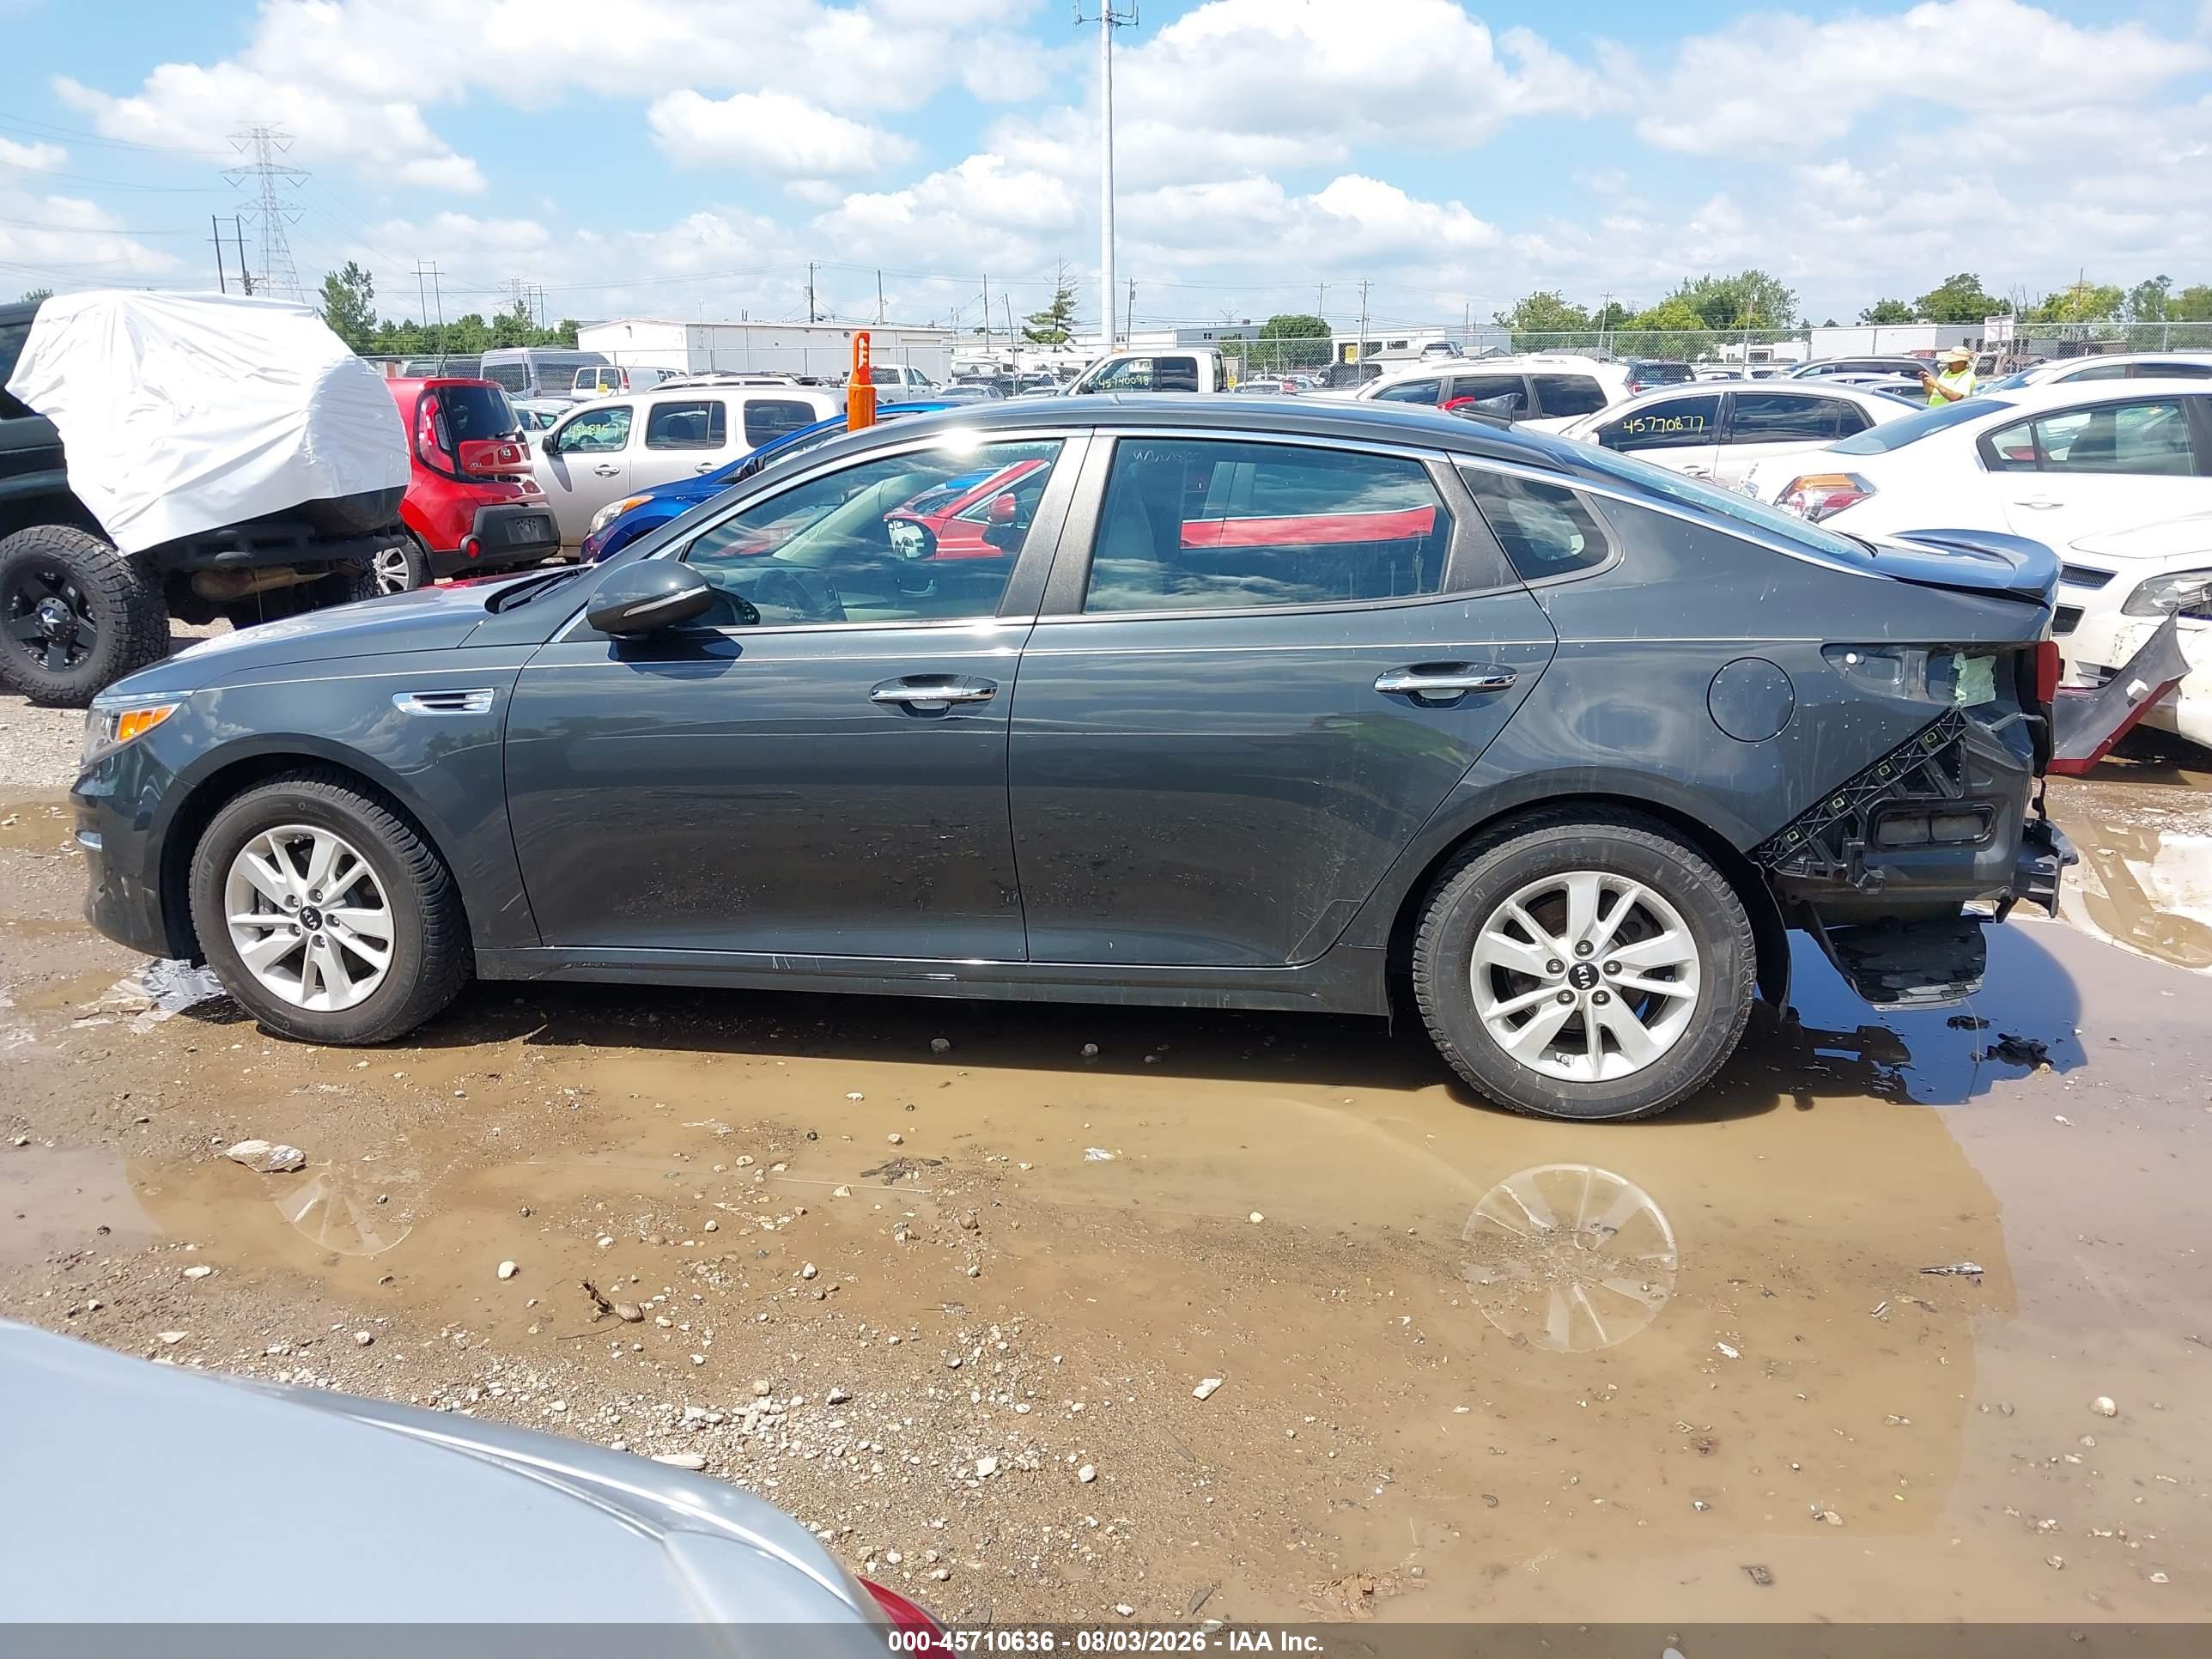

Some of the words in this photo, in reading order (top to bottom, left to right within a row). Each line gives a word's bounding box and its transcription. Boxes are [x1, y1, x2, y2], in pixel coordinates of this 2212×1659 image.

[1098, 374, 1149, 390] 45740098
[1623, 415, 1704, 434] 45770877
[302, 908, 318, 930] KIA
[1577, 964, 1592, 989] KIA
